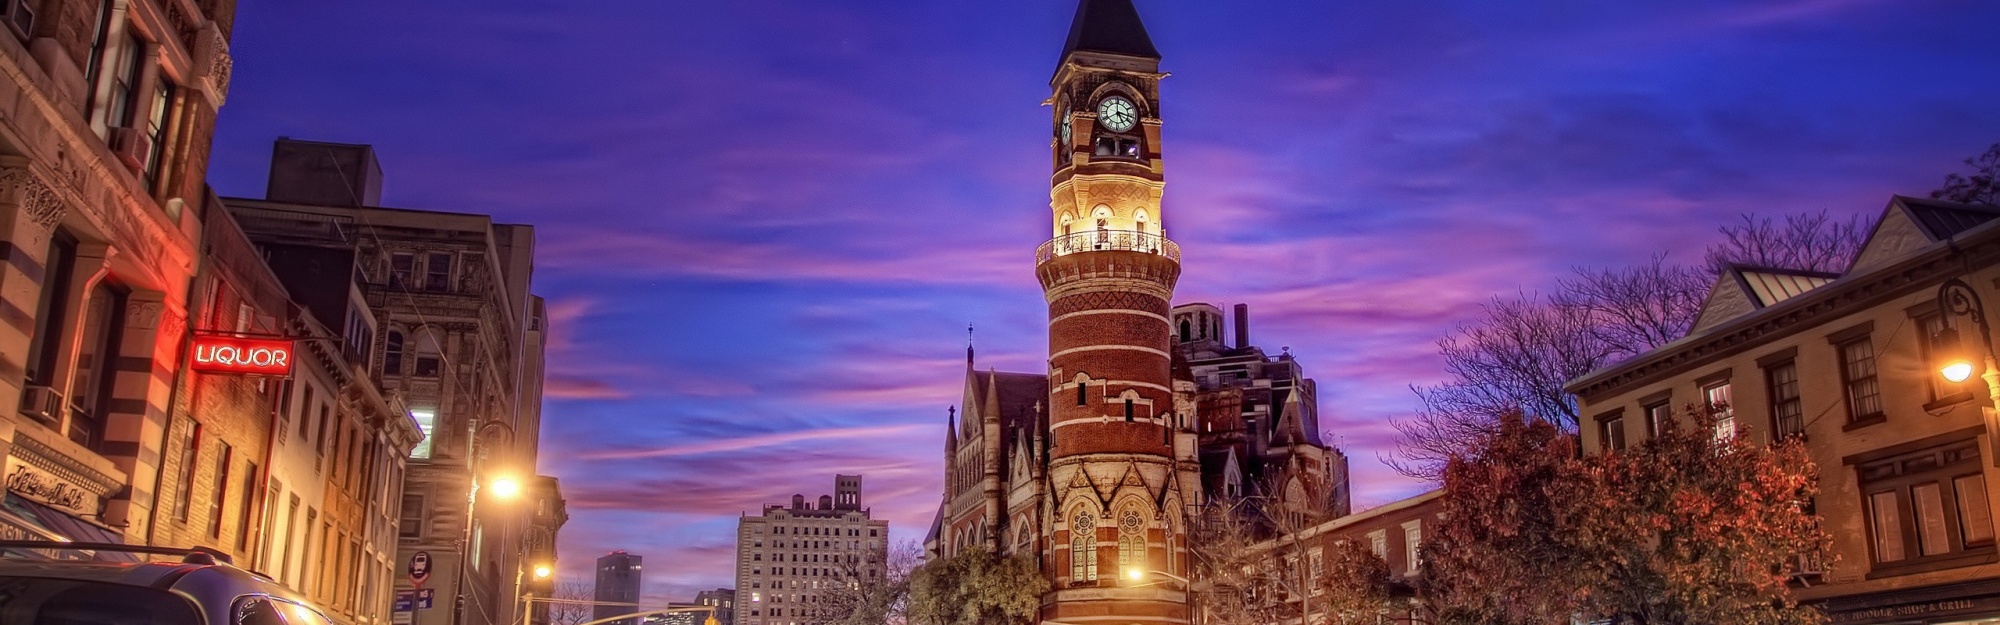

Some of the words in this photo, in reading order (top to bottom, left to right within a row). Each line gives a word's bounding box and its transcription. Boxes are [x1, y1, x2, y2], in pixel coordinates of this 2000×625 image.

[196, 345, 287, 367] LIQUOR
[1852, 608, 1893, 620] NOODLE
[1898, 605, 1926, 616] SHOP
[1929, 603, 1937, 612] &
[1940, 600, 1974, 611] GRILL
